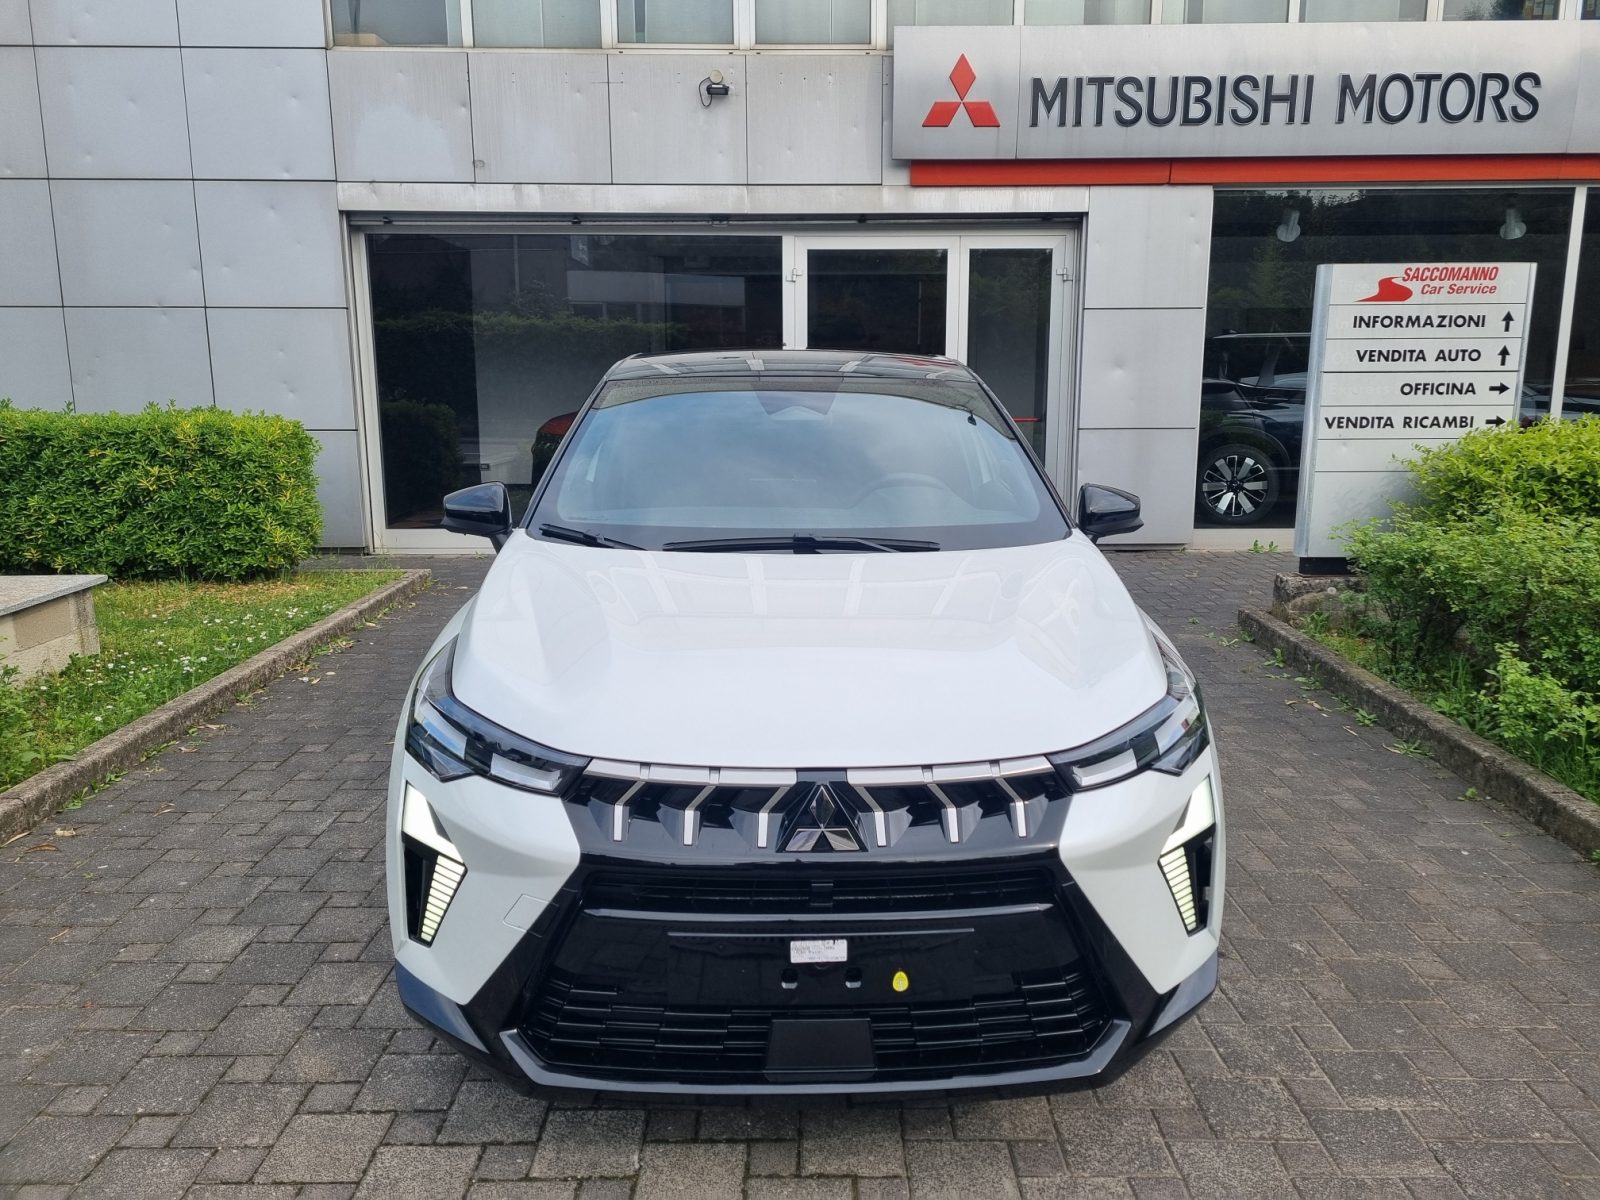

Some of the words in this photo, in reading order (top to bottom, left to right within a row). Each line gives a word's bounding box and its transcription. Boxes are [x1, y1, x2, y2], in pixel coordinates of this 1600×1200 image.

[1030, 74, 1314, 128] MITSUBISHI
[1335, 71, 1541, 124] MOTORS
[1402, 266, 1499, 281] SACCOMANNO
[1421, 284, 1443, 295] Car
[1447, 283, 1497, 294] Service
[1353, 315, 1486, 329] INFORMAZIONI
[1356, 349, 1427, 362] VENDITA
[1435, 349, 1481, 362] AUTO
[1400, 382, 1477, 396] OFFICINA
[1325, 416, 1395, 429] VENDITA
[1403, 416, 1474, 429] RICAMBI
